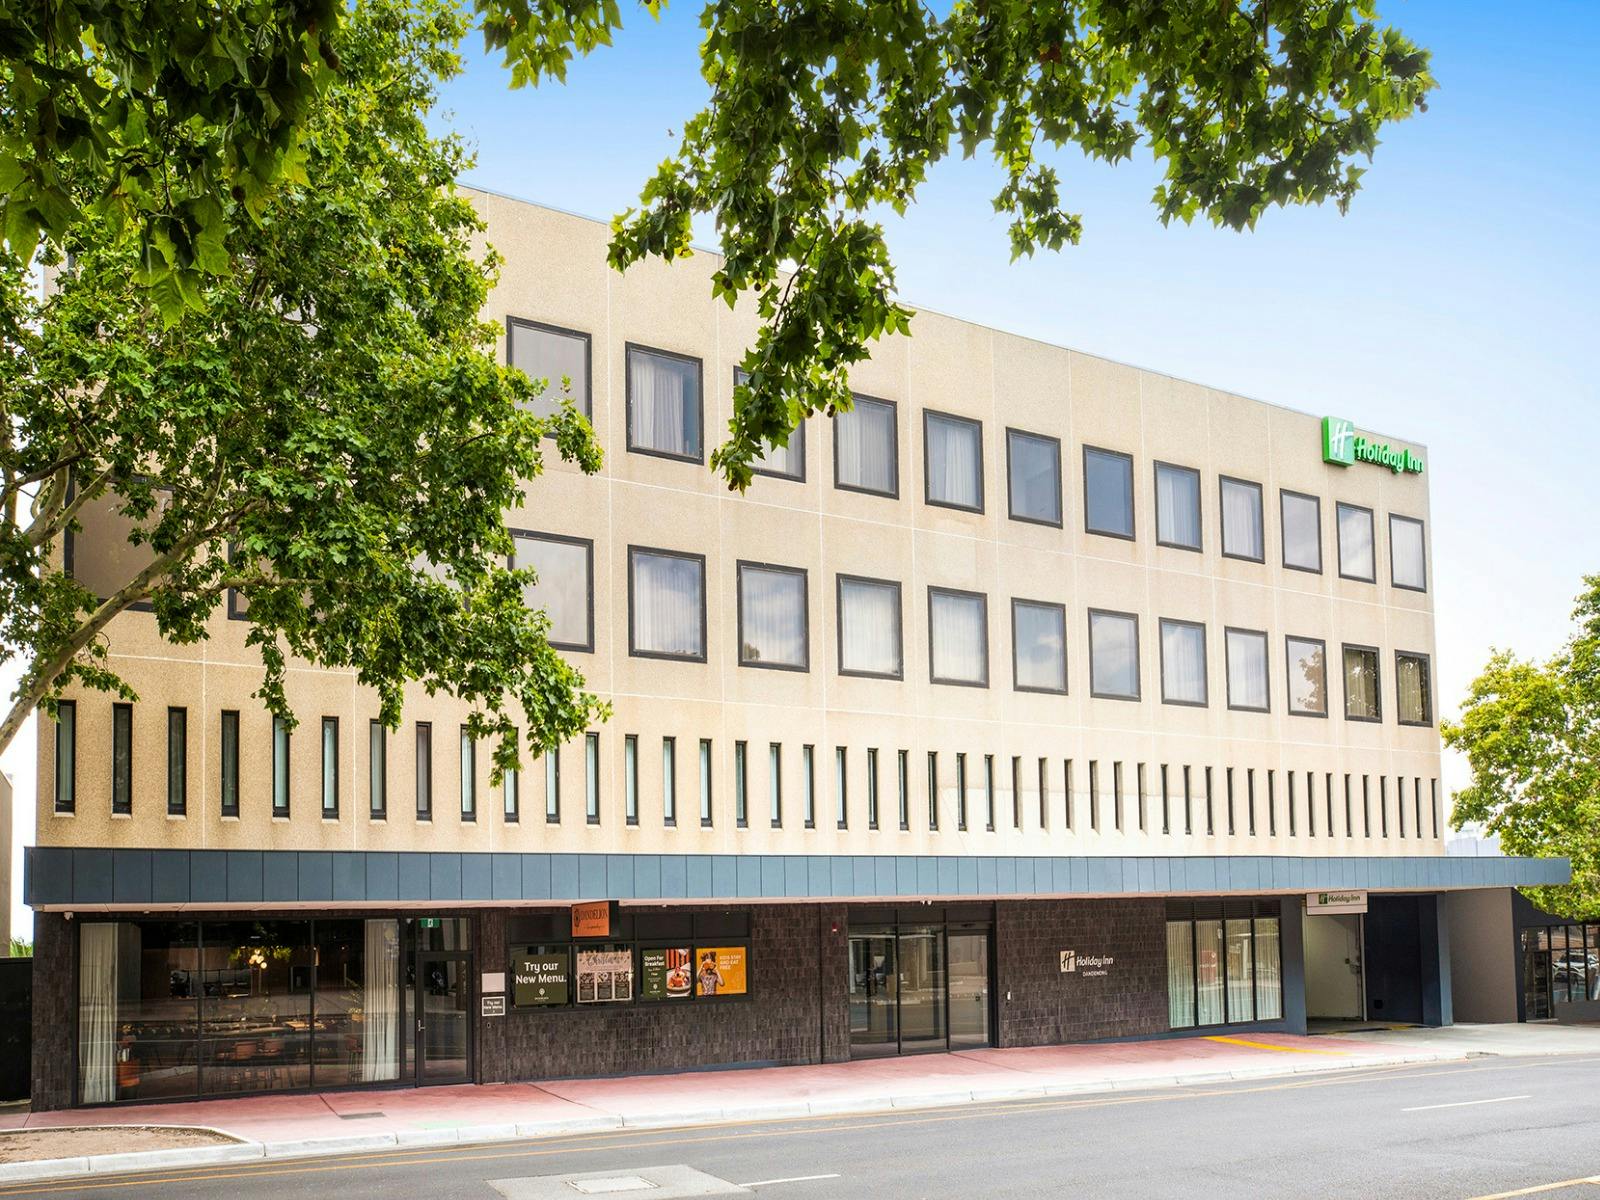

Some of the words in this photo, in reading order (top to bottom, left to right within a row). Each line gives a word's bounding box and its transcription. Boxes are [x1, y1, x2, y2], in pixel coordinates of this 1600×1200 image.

[1355, 437, 1404, 473] Holiday
[1403, 449, 1424, 473] Inn
[1328, 895, 1351, 903] Holiday
[1076, 955, 1102, 967] Holiday
[1102, 955, 1114, 965] Inn
[524, 961, 540, 974] Try
[542, 962, 559, 971] our
[515, 974, 537, 984] New
[538, 973, 567, 983] Menu.
